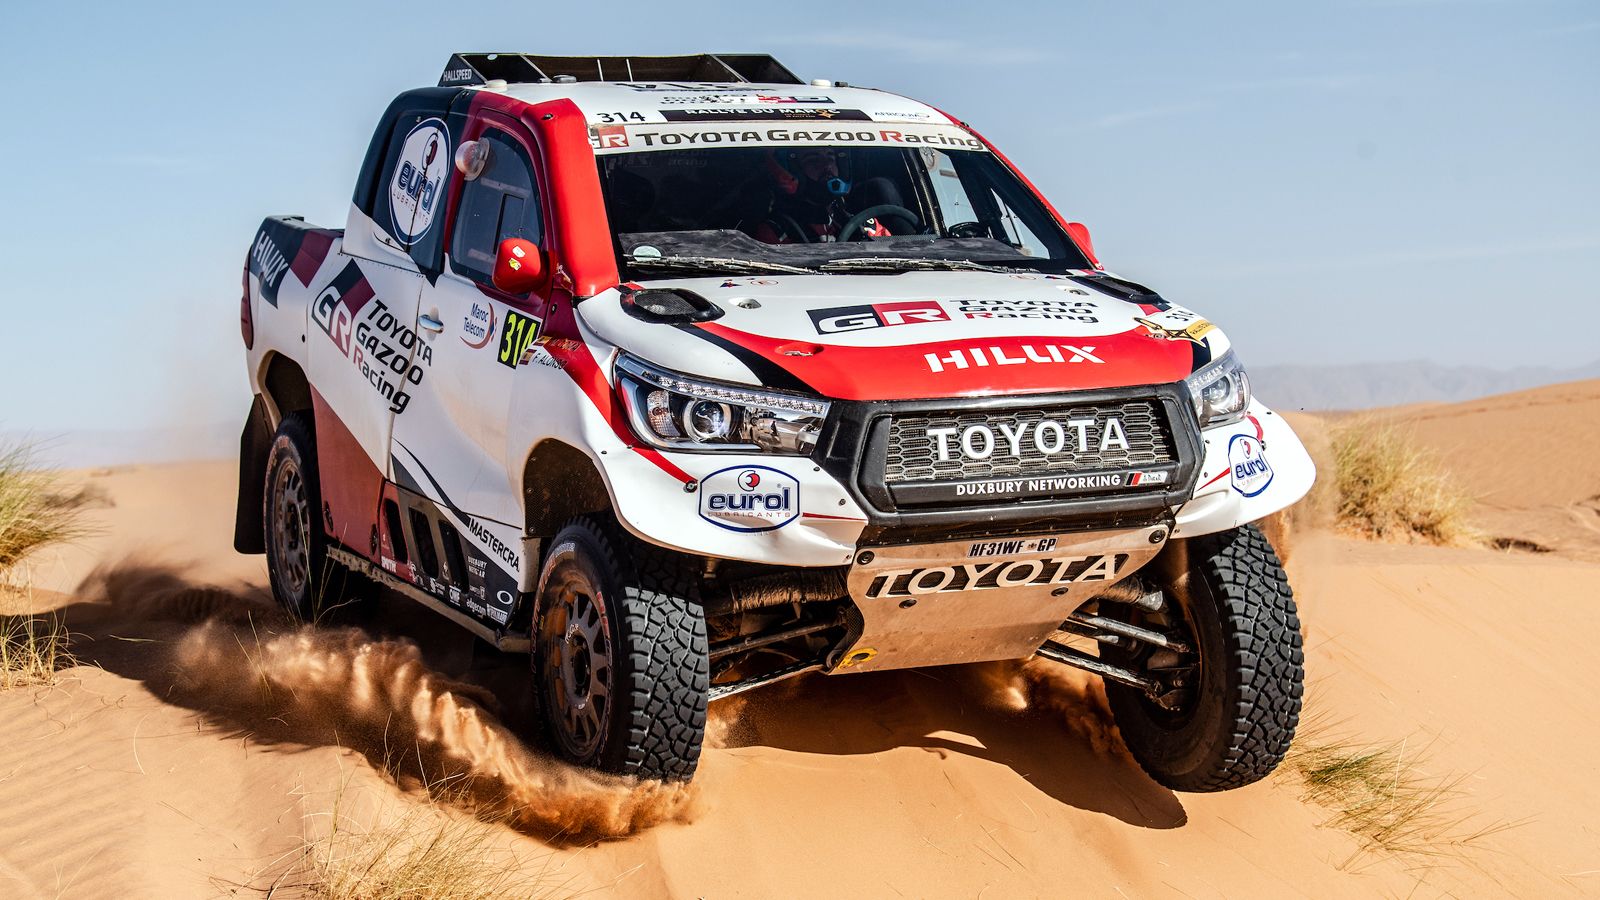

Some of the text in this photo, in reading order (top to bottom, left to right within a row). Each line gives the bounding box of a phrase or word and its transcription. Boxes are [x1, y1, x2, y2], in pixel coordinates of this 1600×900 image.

[443, 69, 472, 82] HALLSPEED
[597, 111, 646, 123] 314
[635, 130, 762, 146] TOYOTA
[766, 129, 876, 143] GAZOO
[879, 129, 984, 151] Racing
[398, 160, 441, 215] eurol
[253, 230, 289, 288] HILUX
[471, 302, 489, 322] Maroc
[950, 299, 1098, 308] TOYOTA
[958, 305, 1093, 314] GAZOO
[311, 285, 353, 360] GR
[463, 317, 486, 338] Telecom
[819, 307, 948, 333] GR
[964, 312, 1099, 324] Racing
[368, 299, 433, 366] TOYOTA
[355, 322, 424, 386] GAZOO
[922, 345, 1106, 374] HILUX
[353, 345, 411, 414] Racing
[926, 417, 1131, 463] TOYOTA
[1235, 452, 1268, 481] eurol
[955, 474, 1121, 497] DUXBURY NETWORKING
[708, 487, 791, 511] eurol
[969, 537, 1057, 557] HF31WF GP
[873, 554, 1121, 598] TOYOTA
